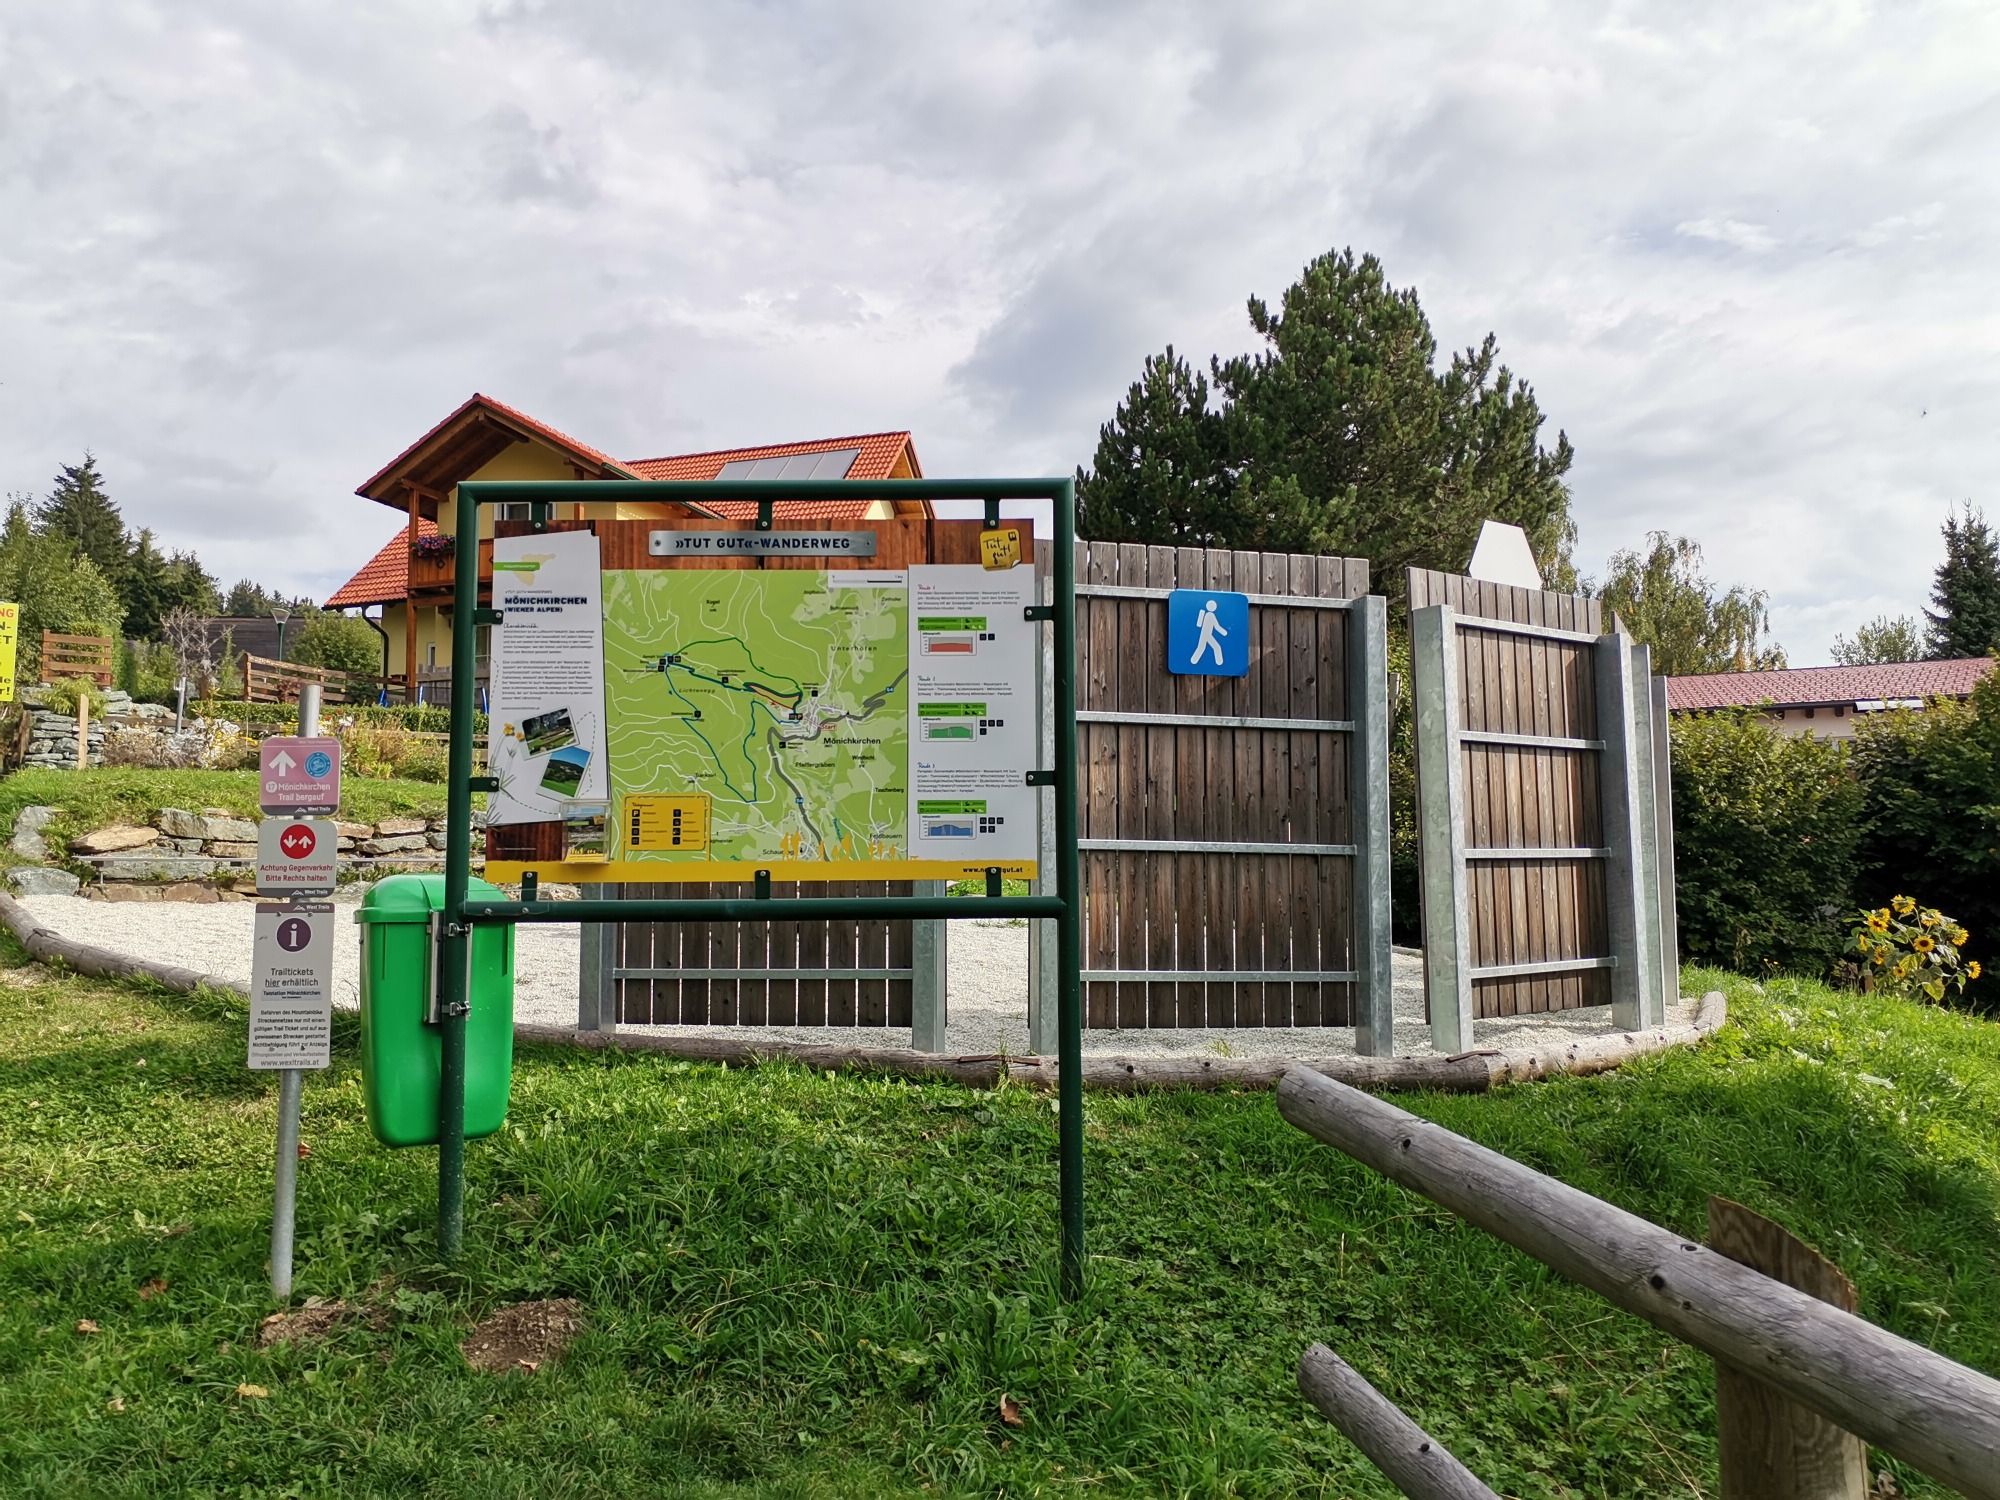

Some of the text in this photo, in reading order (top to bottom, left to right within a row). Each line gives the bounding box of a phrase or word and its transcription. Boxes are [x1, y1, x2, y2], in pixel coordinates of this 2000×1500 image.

[716, 537, 850, 549] GUT«-WANDERWEG
[504, 595, 588, 605] MÖNICHKIRCHEN
[823, 737, 881, 745] Mönichkirchen
[278, 783, 331, 791] Mönichkirchen
[278, 793, 325, 802] Trail bergauf
[260, 864, 333, 872] Achtung Gegenverkehr
[265, 874, 282, 882] Bitte
[283, 874, 305, 882] Rechts
[271, 967, 314, 976] Trailtickets
[265, 978, 319, 987] hier erhältlich
